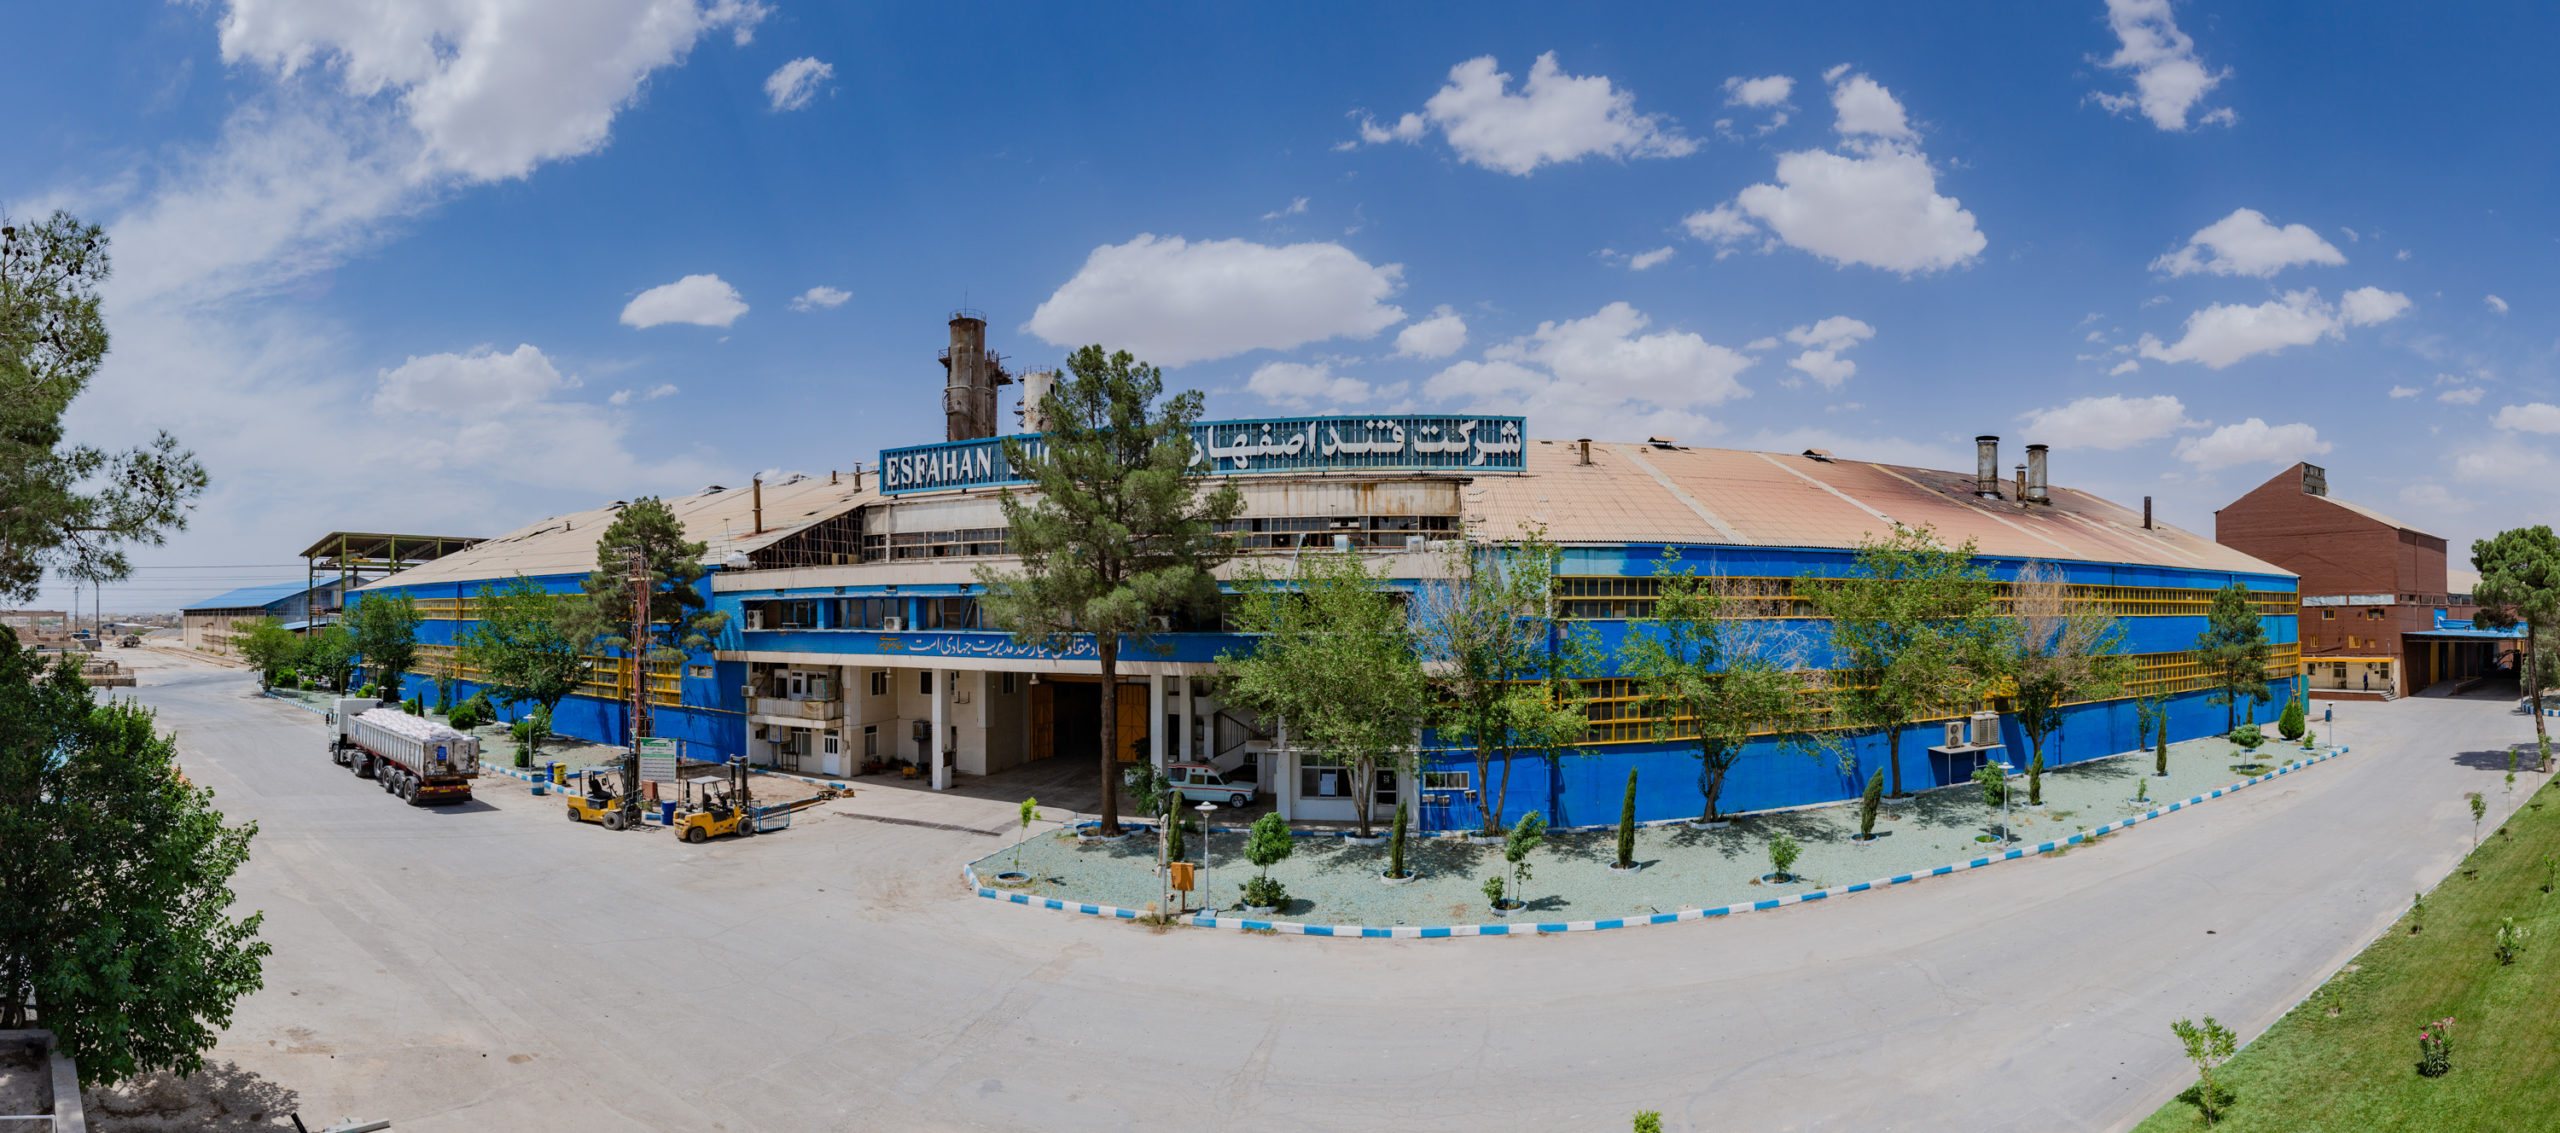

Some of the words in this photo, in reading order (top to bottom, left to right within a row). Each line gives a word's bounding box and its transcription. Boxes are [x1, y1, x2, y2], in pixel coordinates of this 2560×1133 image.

[1321, 420, 1405, 456] قند
[1414, 421, 1521, 466] شرکت
[887, 446, 992, 486] ESFAHAN
[908, 636, 940, 652] است
[941, 636, 972, 655] جهادی
[972, 639, 1014, 657] مدیریت
